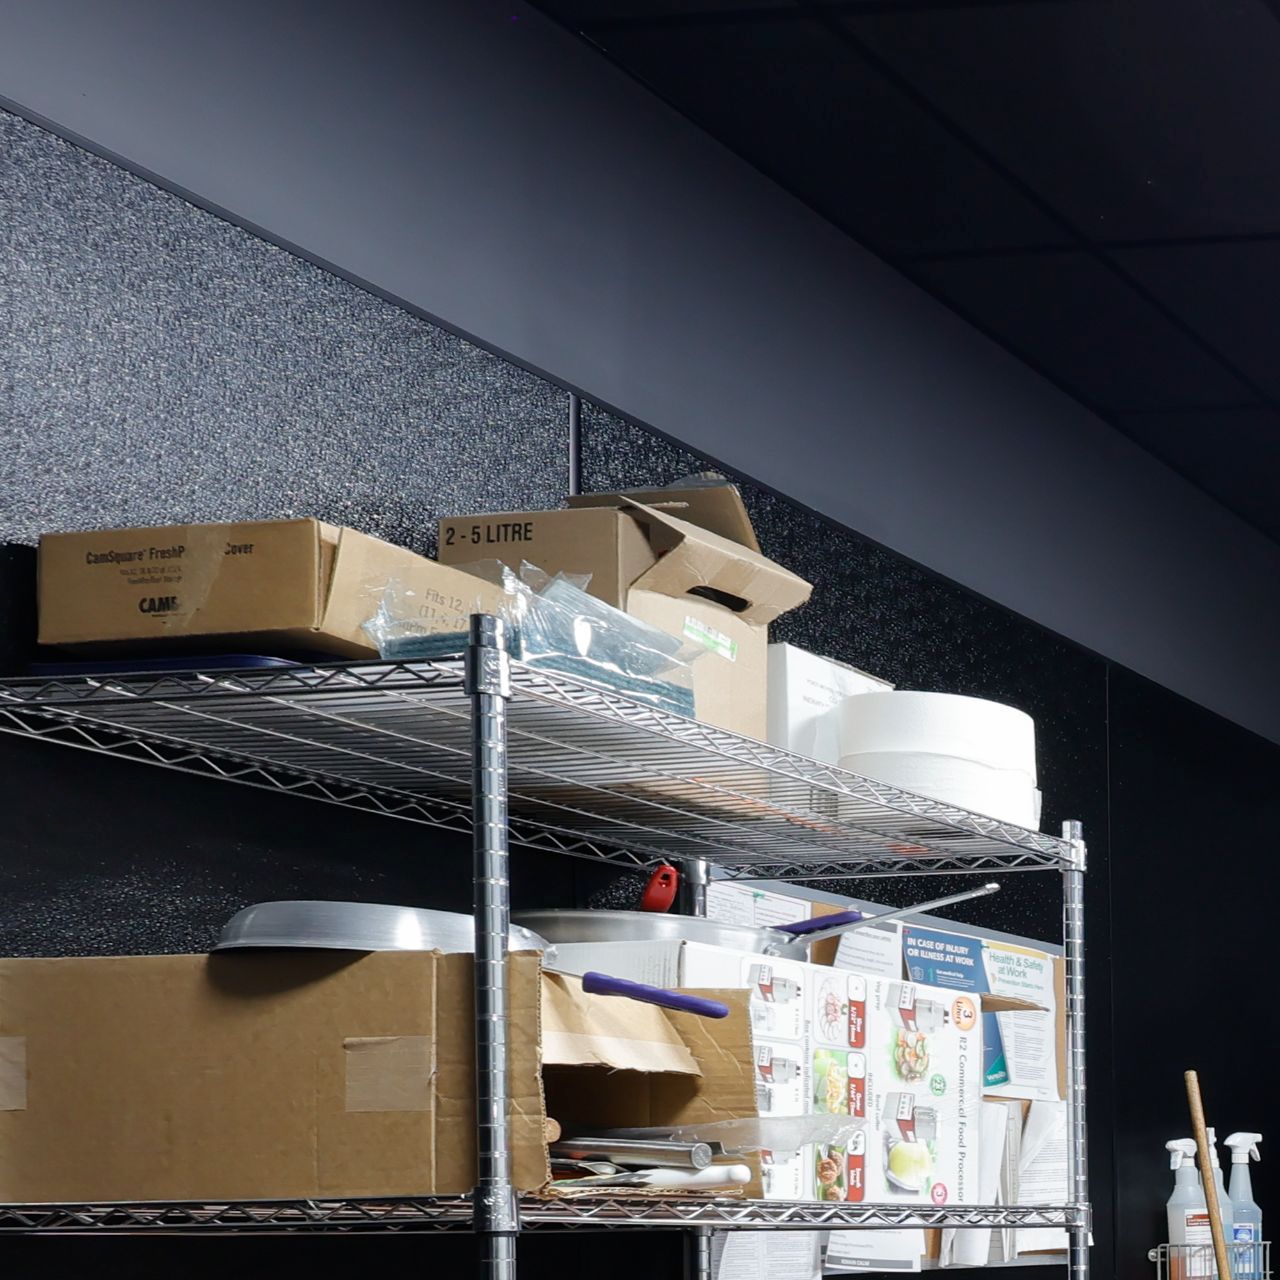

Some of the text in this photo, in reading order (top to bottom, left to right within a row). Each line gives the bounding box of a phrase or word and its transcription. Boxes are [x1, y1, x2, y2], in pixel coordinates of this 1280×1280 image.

[446, 527, 456, 545] 2
[471, 525, 481, 544] 5
[486, 522, 533, 543] LITRE
[149, 545, 185, 560] FreshP
[907, 937, 969, 955] IN CASE OF INJURY
[907, 948, 974, 967] OR ILLNESS AT WORK
[989, 951, 1044, 974] Health & Safety
[1006, 966, 1027, 978] Work
[955, 1000, 963, 1025] Liters
[958, 1122, 967, 1148] Food
[957, 1152, 967, 1202] Processor
